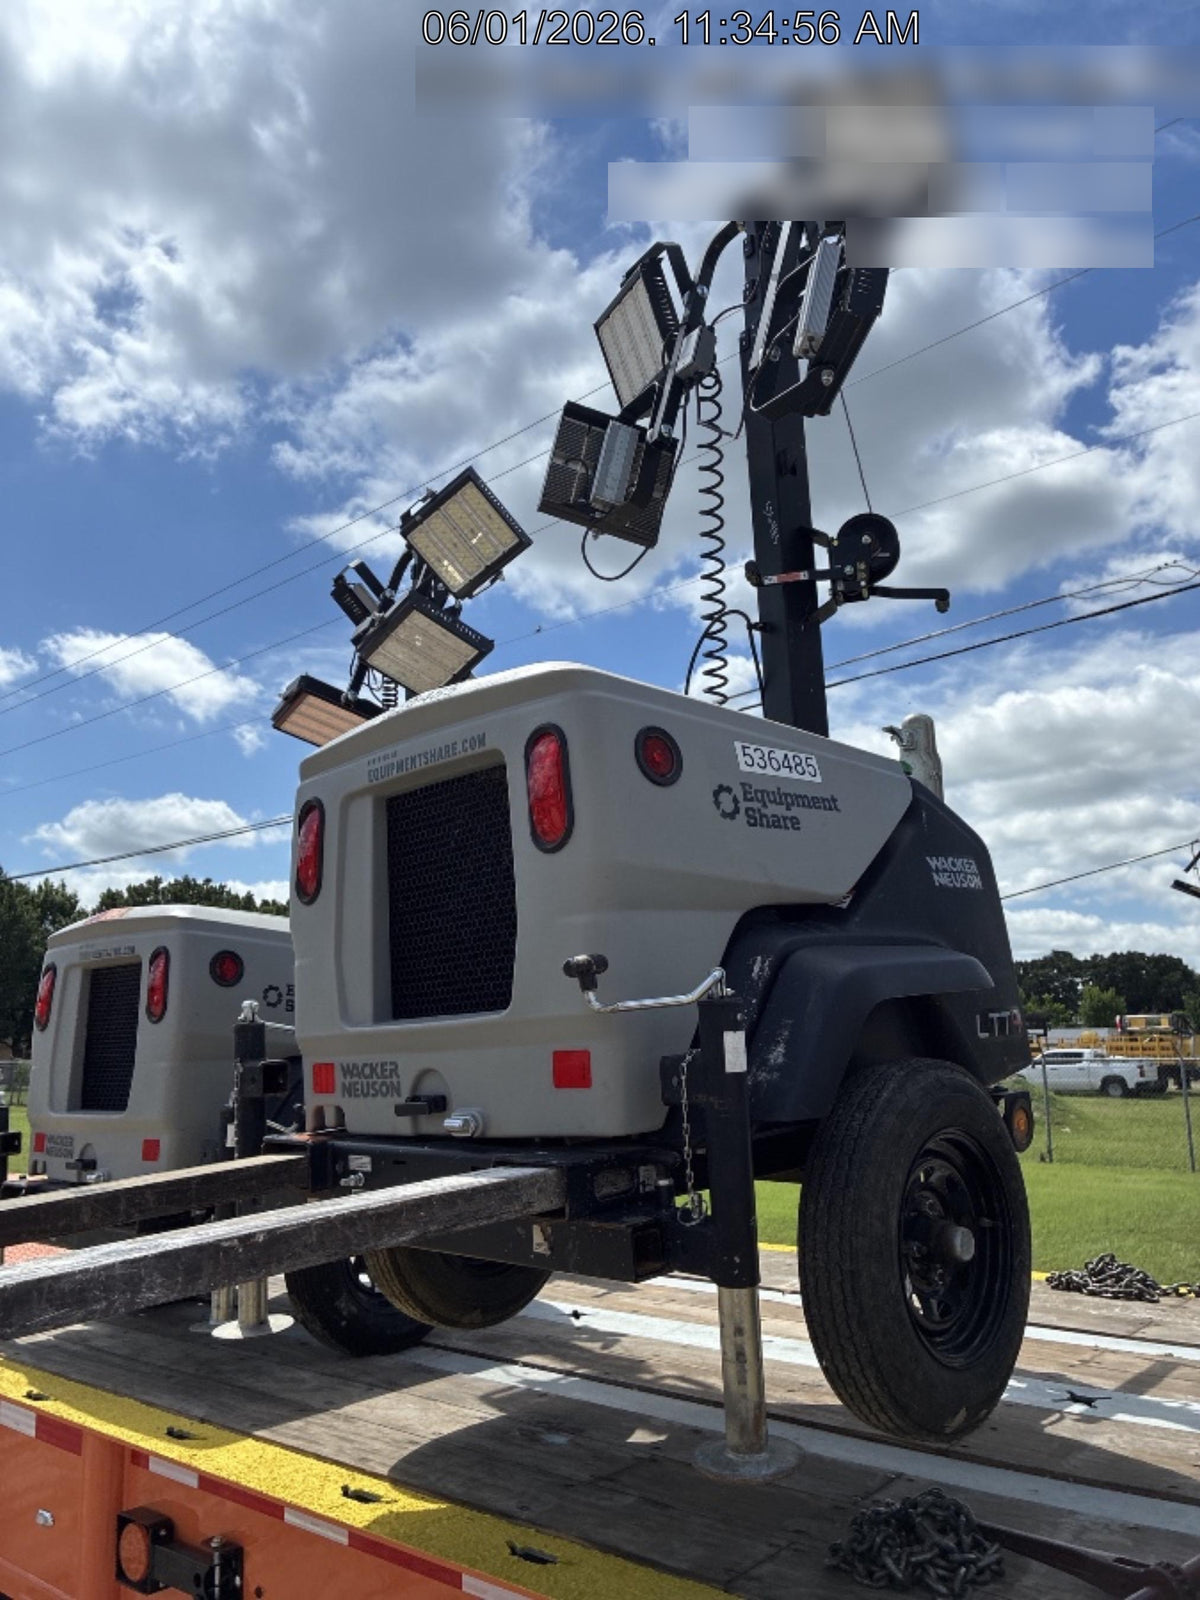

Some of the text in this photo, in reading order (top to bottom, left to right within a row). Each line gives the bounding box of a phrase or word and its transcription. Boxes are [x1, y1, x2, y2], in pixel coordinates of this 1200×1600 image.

[367, 732, 486, 783] EQUIPMENTSHARE.COM
[741, 744, 817, 778] 536485
[740, 782, 841, 812] Equipment
[745, 807, 801, 831] Share
[926, 856, 979, 874] WACKER
[340, 1061, 400, 1080] WACKER
[341, 1079, 402, 1099] NEUSON
